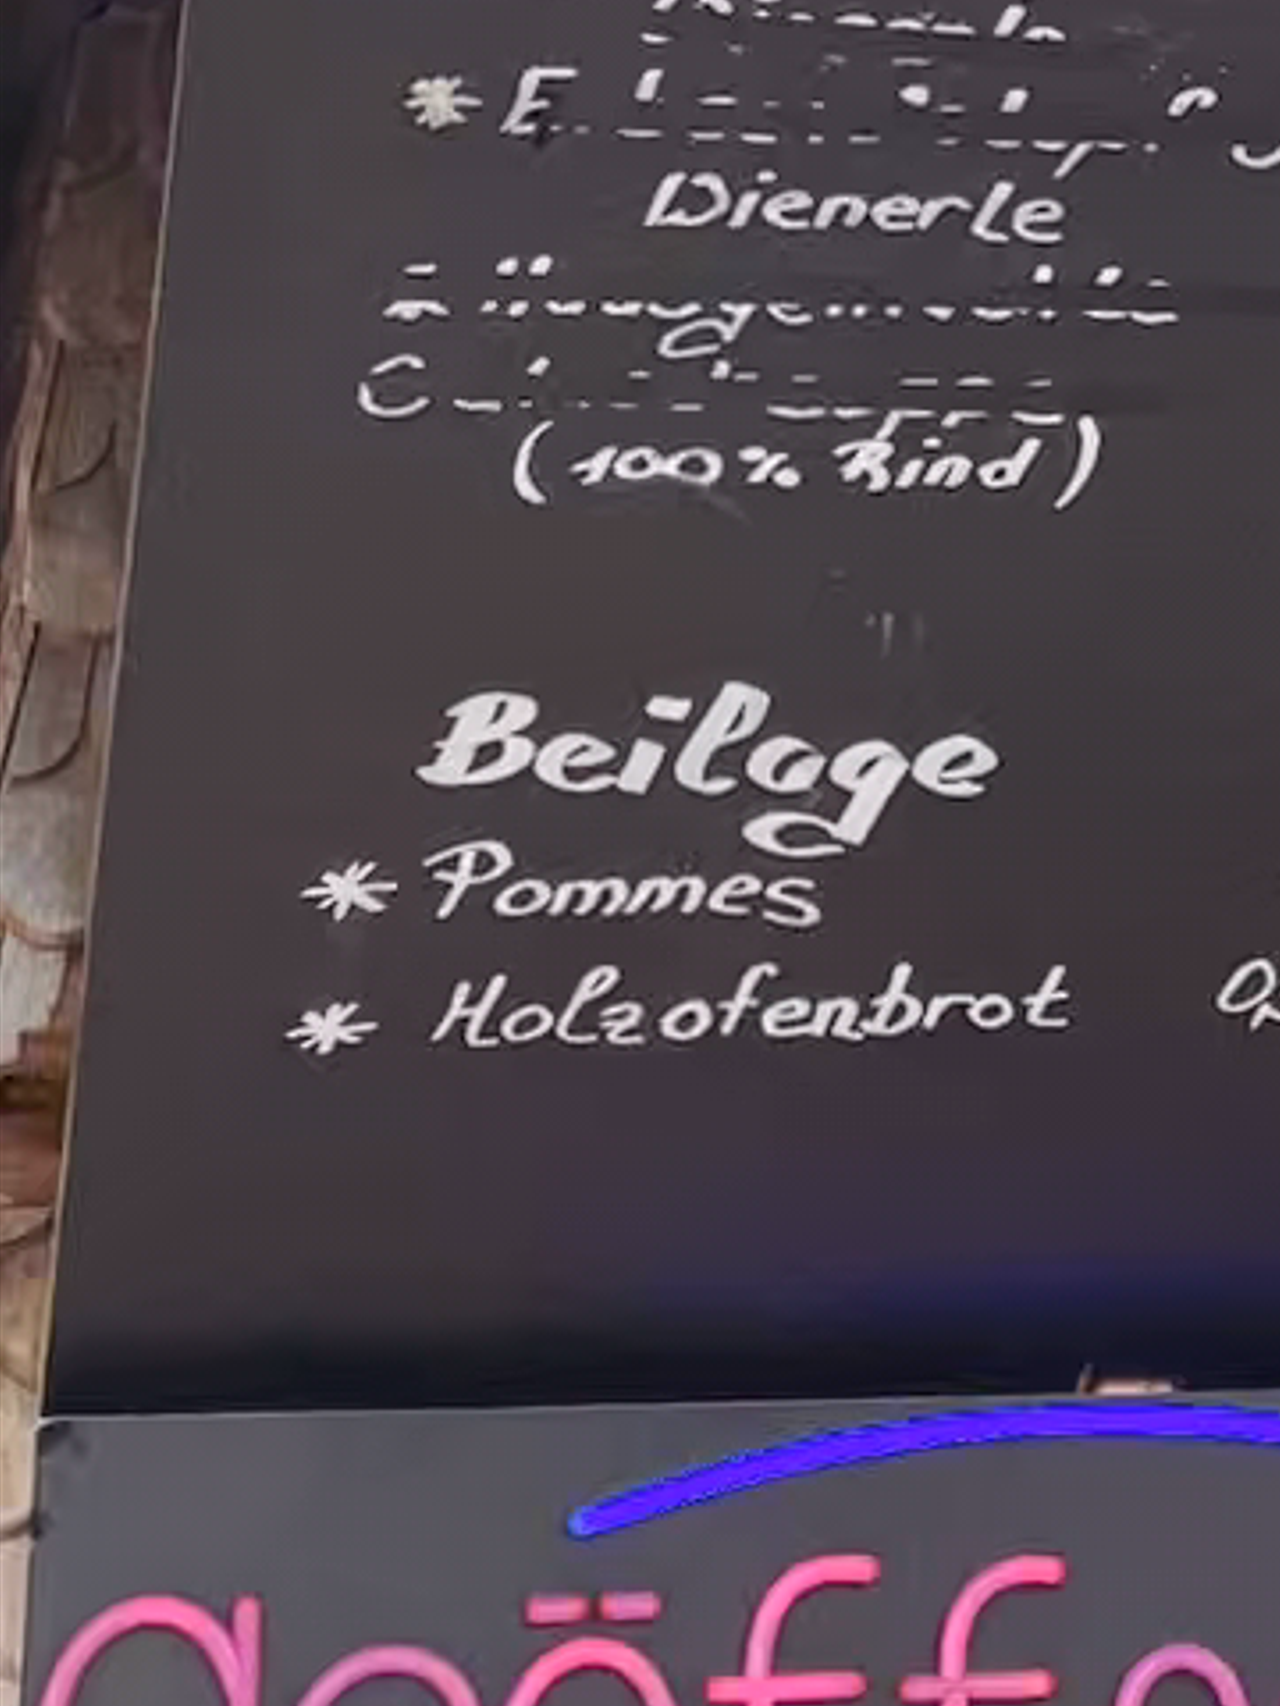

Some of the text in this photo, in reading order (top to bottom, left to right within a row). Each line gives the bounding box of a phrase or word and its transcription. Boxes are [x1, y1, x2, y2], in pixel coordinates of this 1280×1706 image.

[640, 168, 1070, 244] Dienerle
[508, 414, 1105, 514] (100% Rind)
[412, 676, 1002, 861] Beilage
[420, 836, 828, 931] Pommes
[428, 960, 1075, 1050] Holzofenbrot
